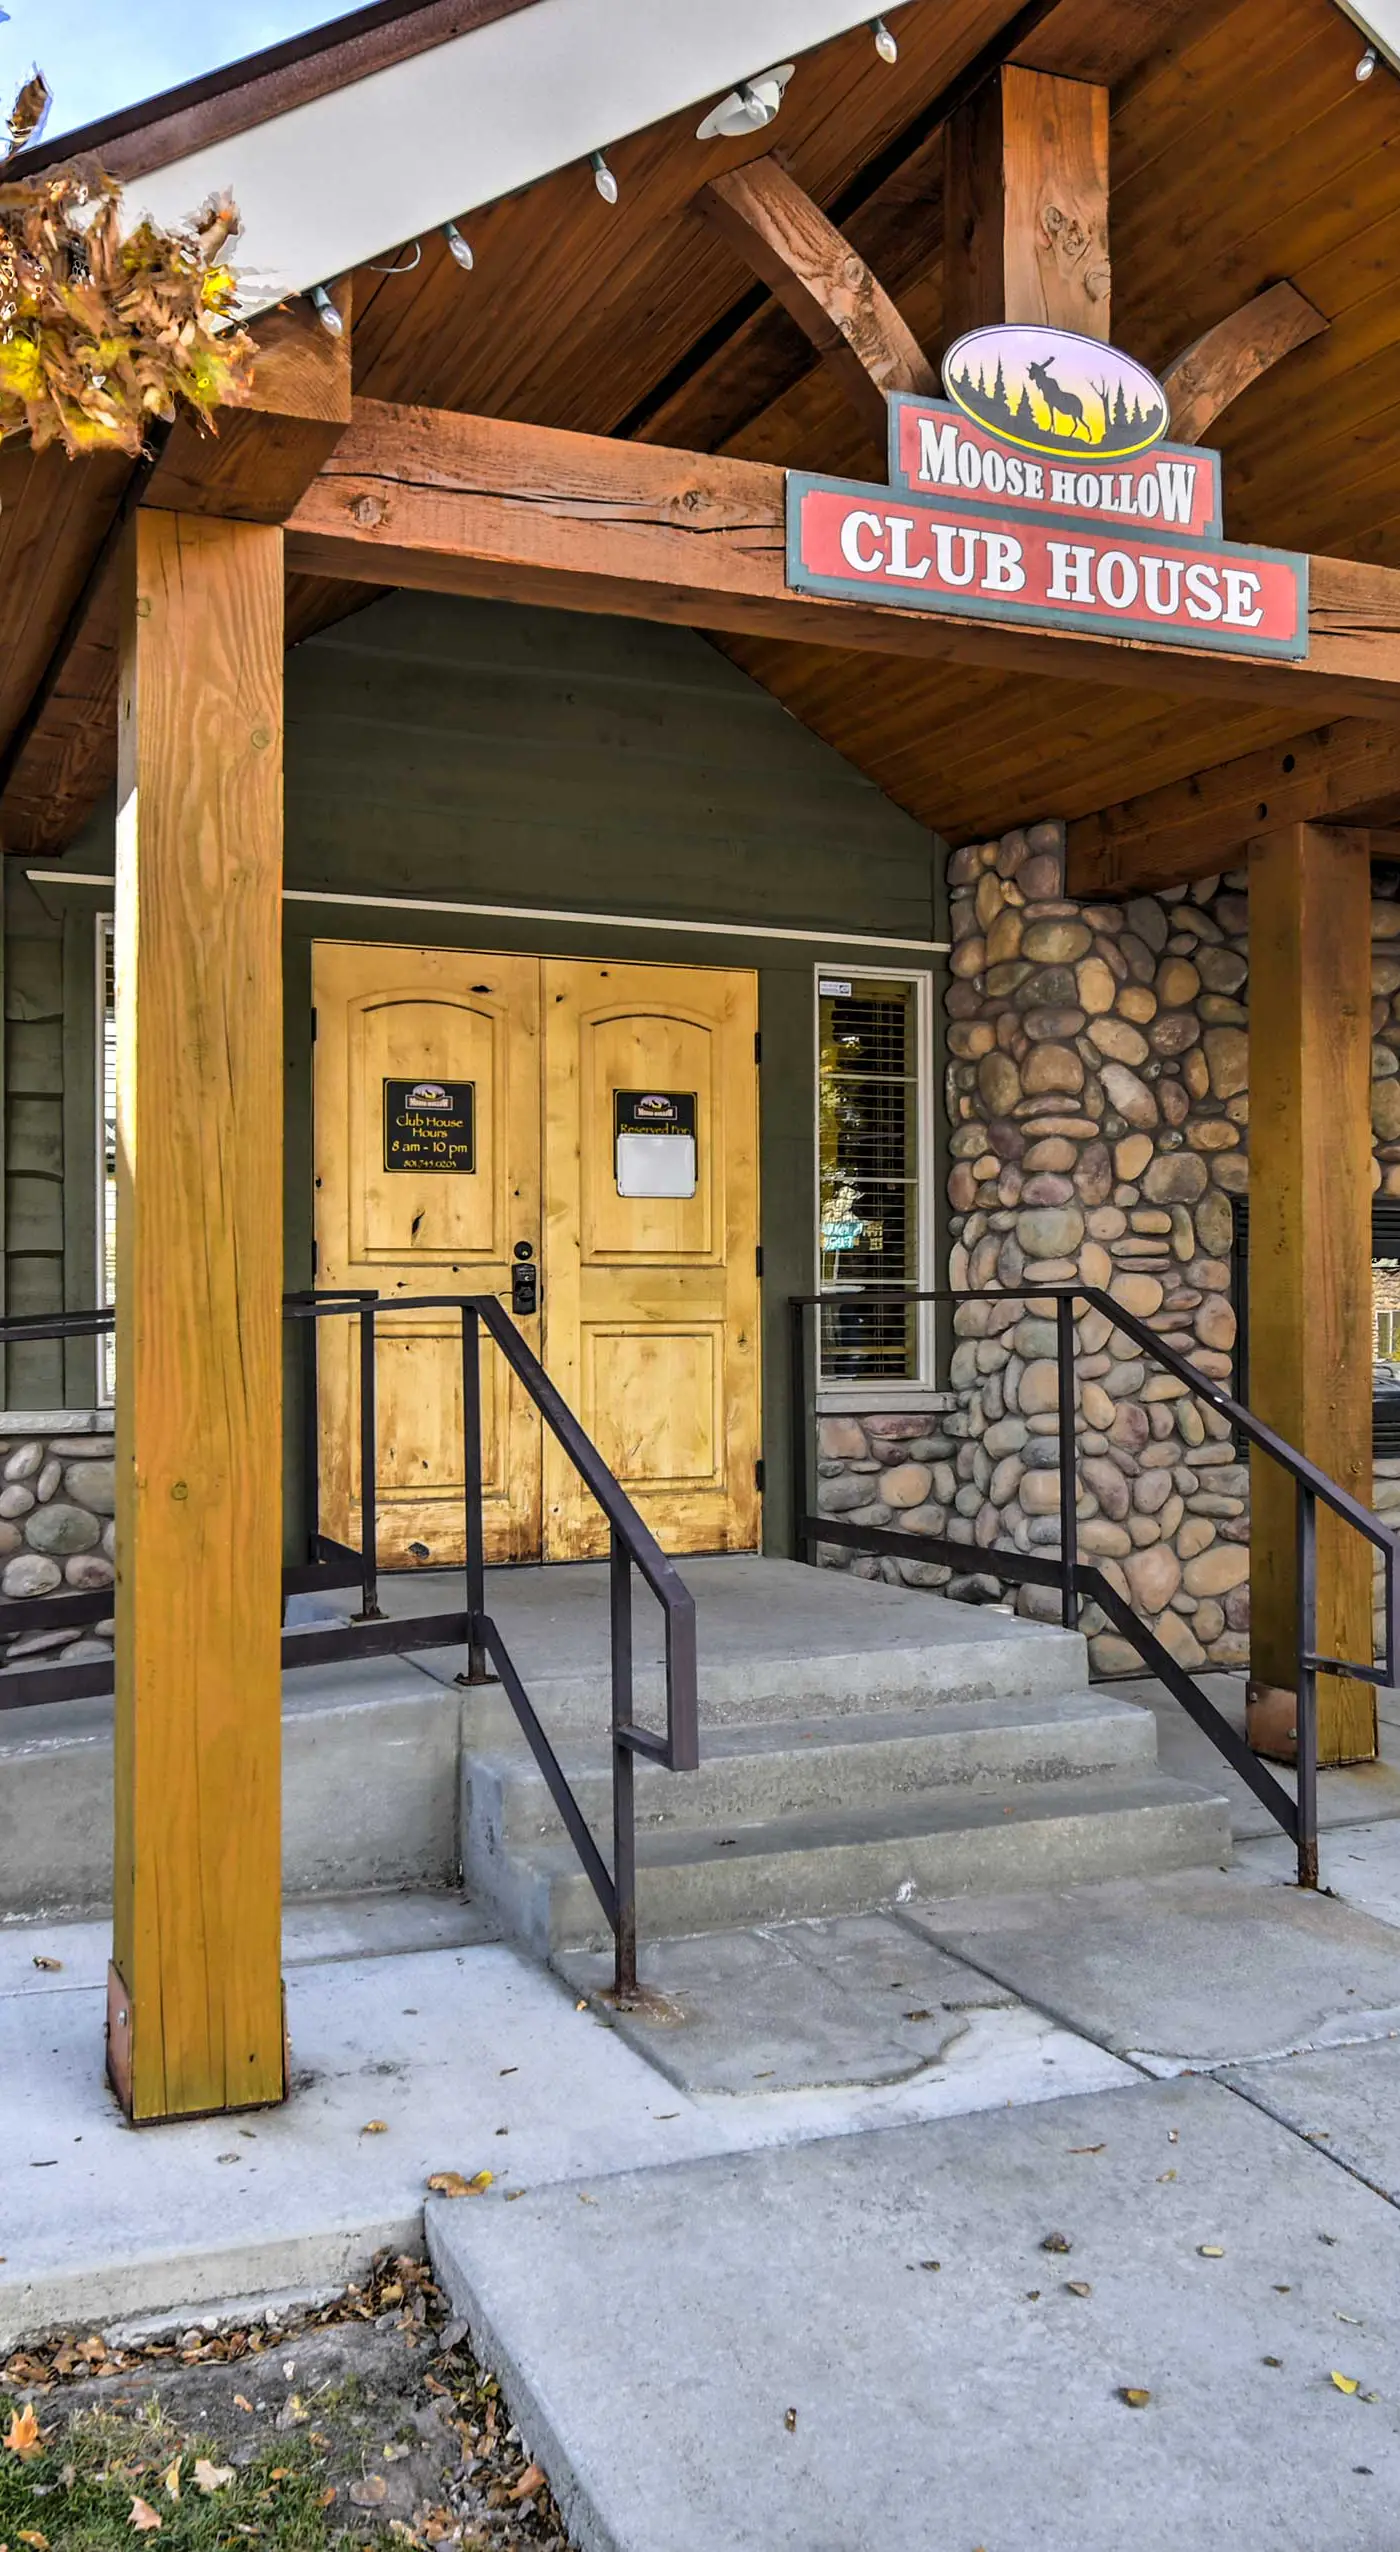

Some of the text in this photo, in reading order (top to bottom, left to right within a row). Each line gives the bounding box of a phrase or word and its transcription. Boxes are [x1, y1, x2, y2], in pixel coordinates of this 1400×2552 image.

[916, 418, 1198, 525] MOOSE HOLLOW
[839, 510, 1265, 627] CLUB HOUSE
[396, 1112, 464, 1128] Club House
[620, 1122, 669, 1134] Reserved
[412, 1127, 448, 1138] Hours
[391, 1140, 400, 1152] 8
[402, 1143, 420, 1152] am
[433, 1141, 446, 1153] 10
[448, 1144, 468, 1159] pm
